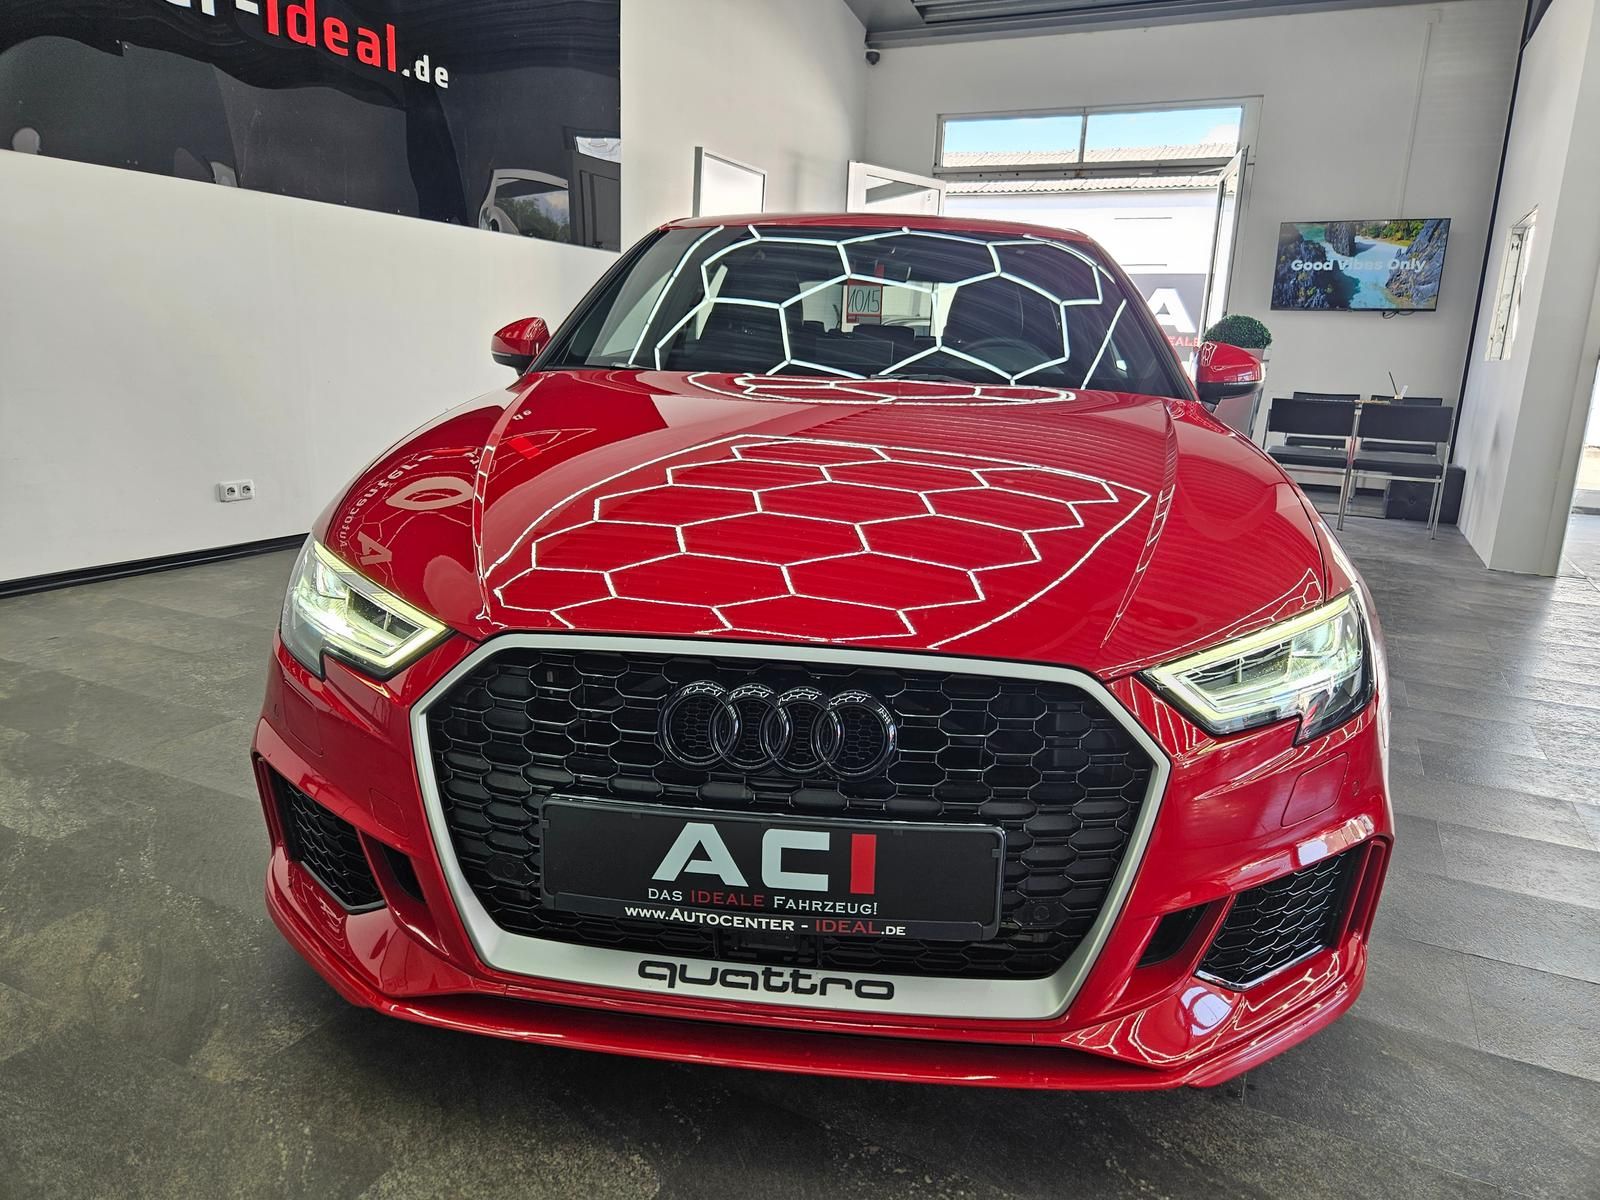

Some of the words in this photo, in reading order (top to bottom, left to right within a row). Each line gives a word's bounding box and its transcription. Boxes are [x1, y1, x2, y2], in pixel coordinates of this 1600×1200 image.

[1291, 259, 1333, 271] Good
[1338, 259, 1384, 271] Vibes
[1388, 258, 1427, 273] Only
[848, 288, 881, 313] 1015
[651, 822, 877, 895] ACI
[648, 888, 683, 901] DAS
[690, 890, 765, 907] IDEALE
[773, 896, 878, 915] FAHRZEUG!
[637, 959, 895, 1001] quattro
